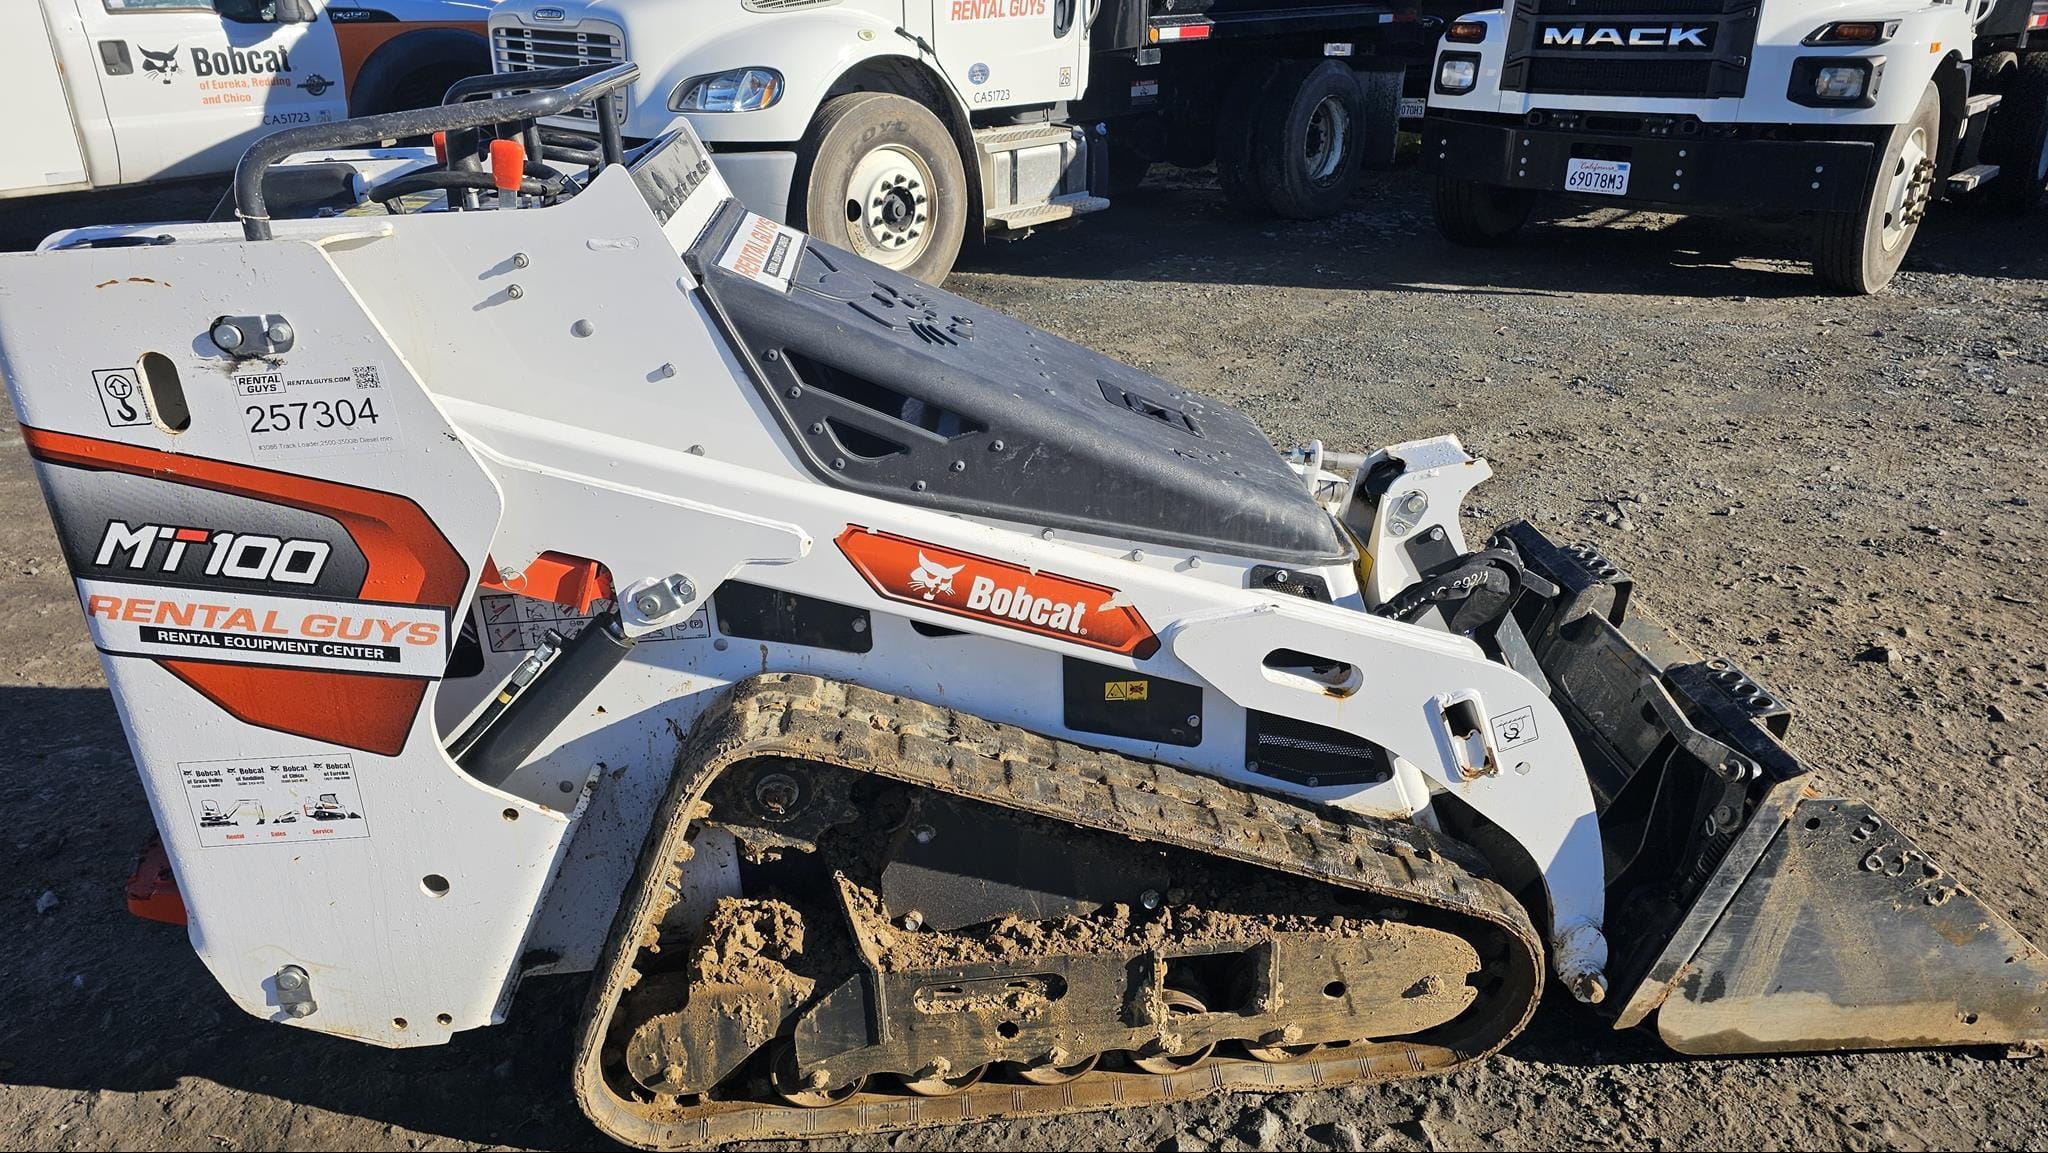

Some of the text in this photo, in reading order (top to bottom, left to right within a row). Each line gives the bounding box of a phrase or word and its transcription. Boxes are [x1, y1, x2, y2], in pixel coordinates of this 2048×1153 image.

[951, 0, 1046, 20] RENTAL GUYS
[1543, 27, 1708, 47] MACK
[190, 45, 292, 77] Bobcat
[200, 76, 291, 90] of Eureka, Redding
[202, 93, 251, 104] and Chico
[974, 89, 1010, 103] CA51723
[263, 112, 310, 125] CA51723
[1580, 162, 1615, 171] California
[1569, 171, 1624, 189] 69078M3
[733, 239, 768, 279] RENTAL
[751, 217, 778, 244] GUYS
[238, 375, 280, 386] RENTAL
[287, 376, 350, 386] RENTALGUYS.COM
[247, 384, 277, 394] GUYS
[246, 397, 379, 434] 257304
[95, 522, 330, 585] MT100
[966, 575, 1086, 634] Bobcat
[88, 594, 441, 646] RENTAL GUYS
[158, 630, 384, 659] RENTAL EQUIPMENT CENTER
[195, 769, 221, 777] Bobcat
[239, 767, 264, 775] Bobcat
[282, 764, 308, 772] Bobcat
